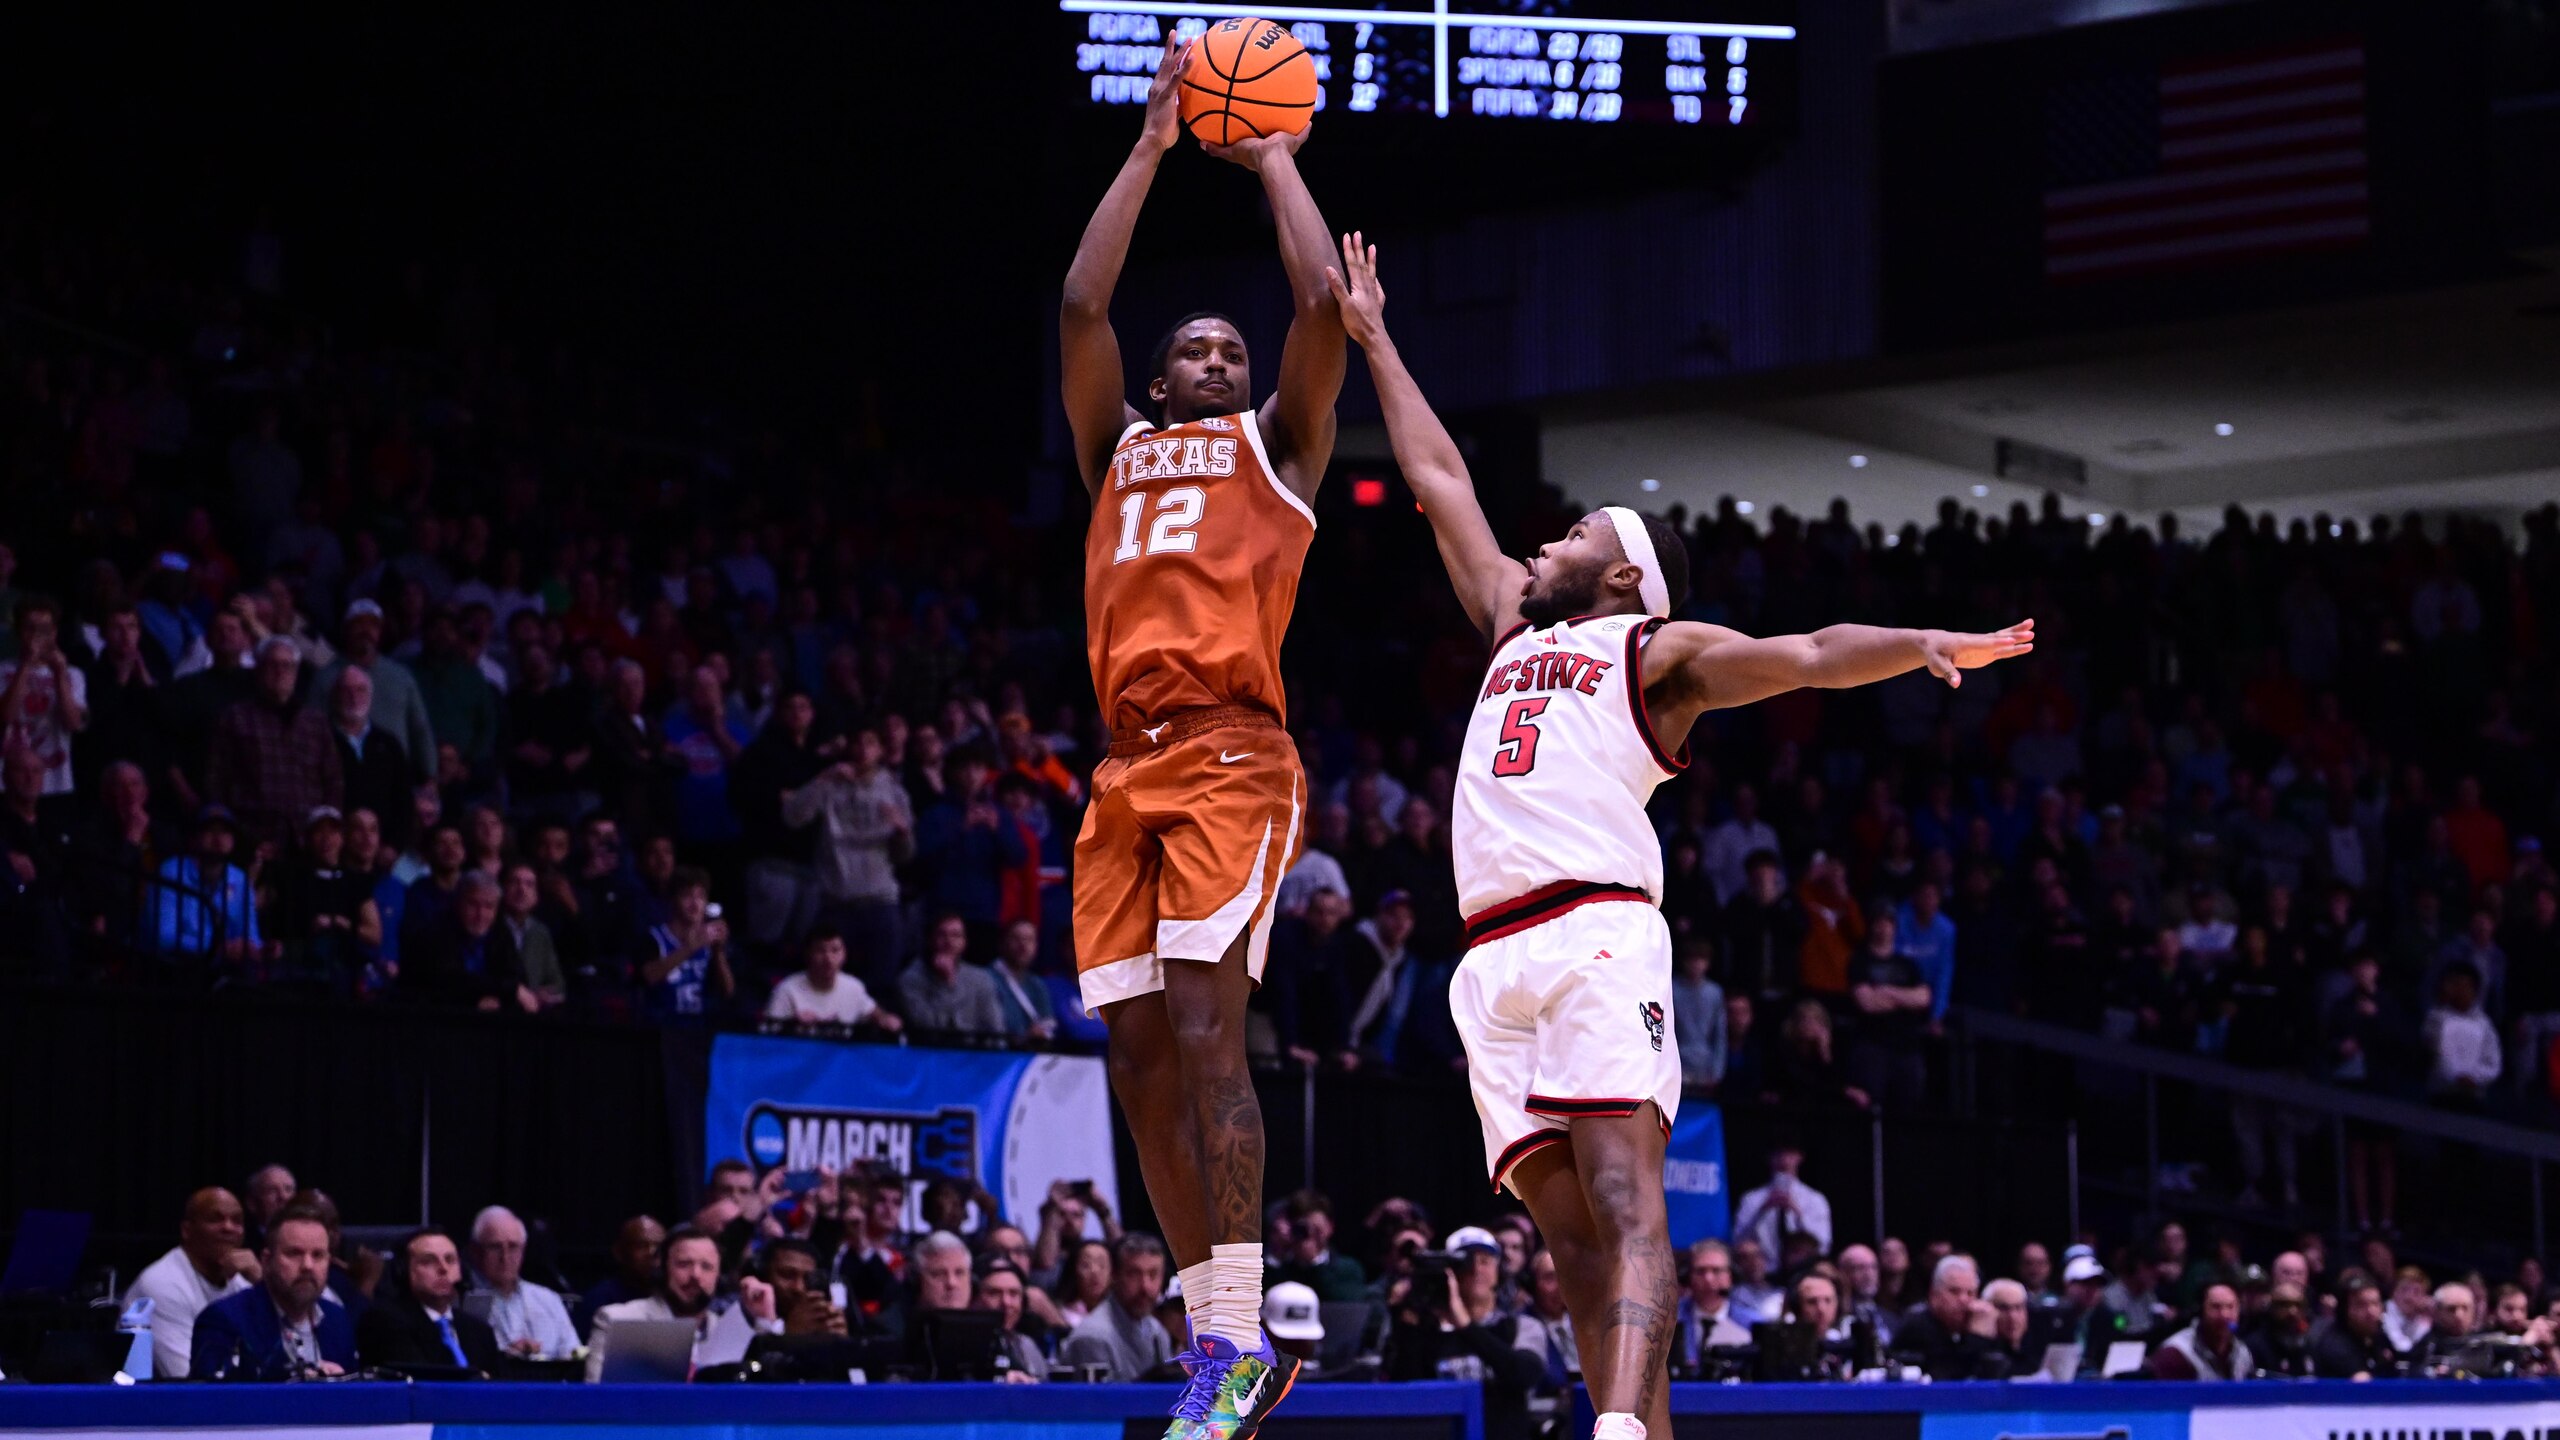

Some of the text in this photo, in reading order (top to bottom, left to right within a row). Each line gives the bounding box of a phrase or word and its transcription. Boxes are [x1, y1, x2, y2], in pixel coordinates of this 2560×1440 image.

[1355, 21, 1374, 49] 7
[1728, 96, 1748, 124] 7
[1201, 417, 1232, 429] SEC
[1112, 437, 1238, 491] TEXAS
[1113, 486, 1206, 565] 12
[1515, 652, 1614, 696] STATE
[1492, 697, 1552, 778] 5
[787, 1118, 912, 1176] MARCH
